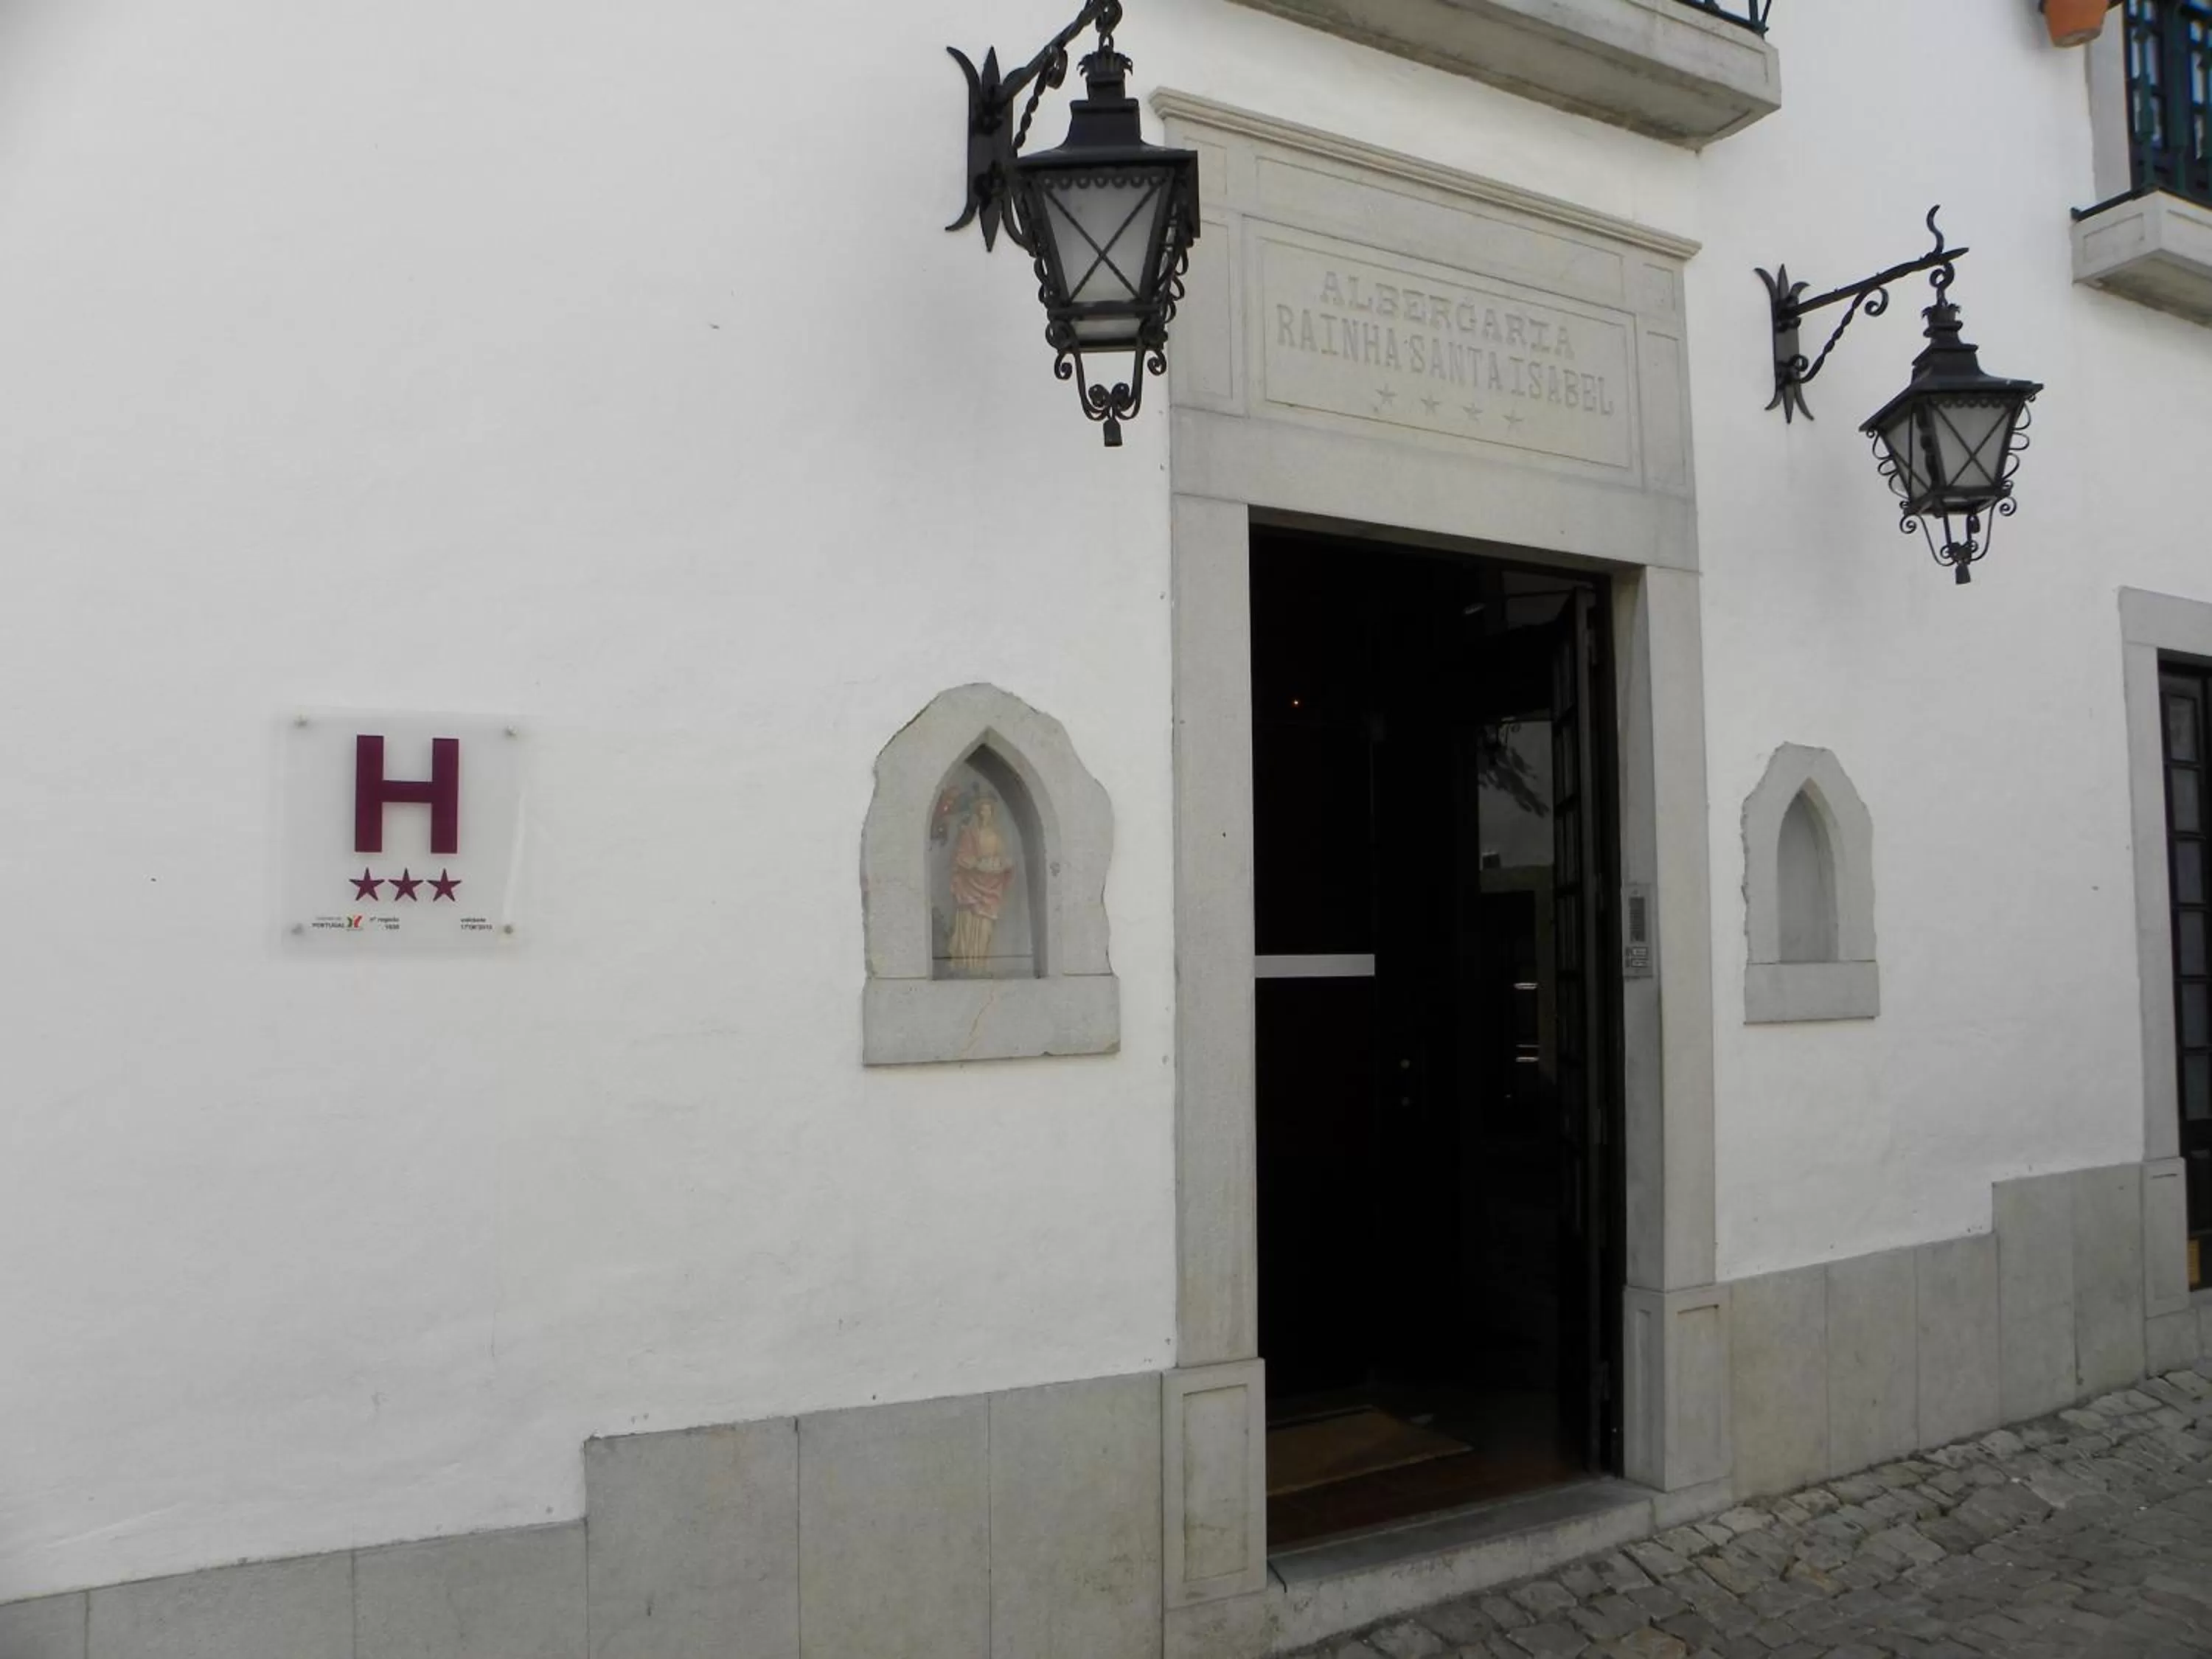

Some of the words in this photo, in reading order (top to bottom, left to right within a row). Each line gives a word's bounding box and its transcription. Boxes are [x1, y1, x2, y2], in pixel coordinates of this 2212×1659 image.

[1276, 303, 1402, 372] RAINHA
[1408, 333, 1504, 391] SANTA
[1509, 354, 1615, 416] ISABEL
[1320, 270, 1576, 361] ALBERGARIA
[355, 734, 459, 854] H
